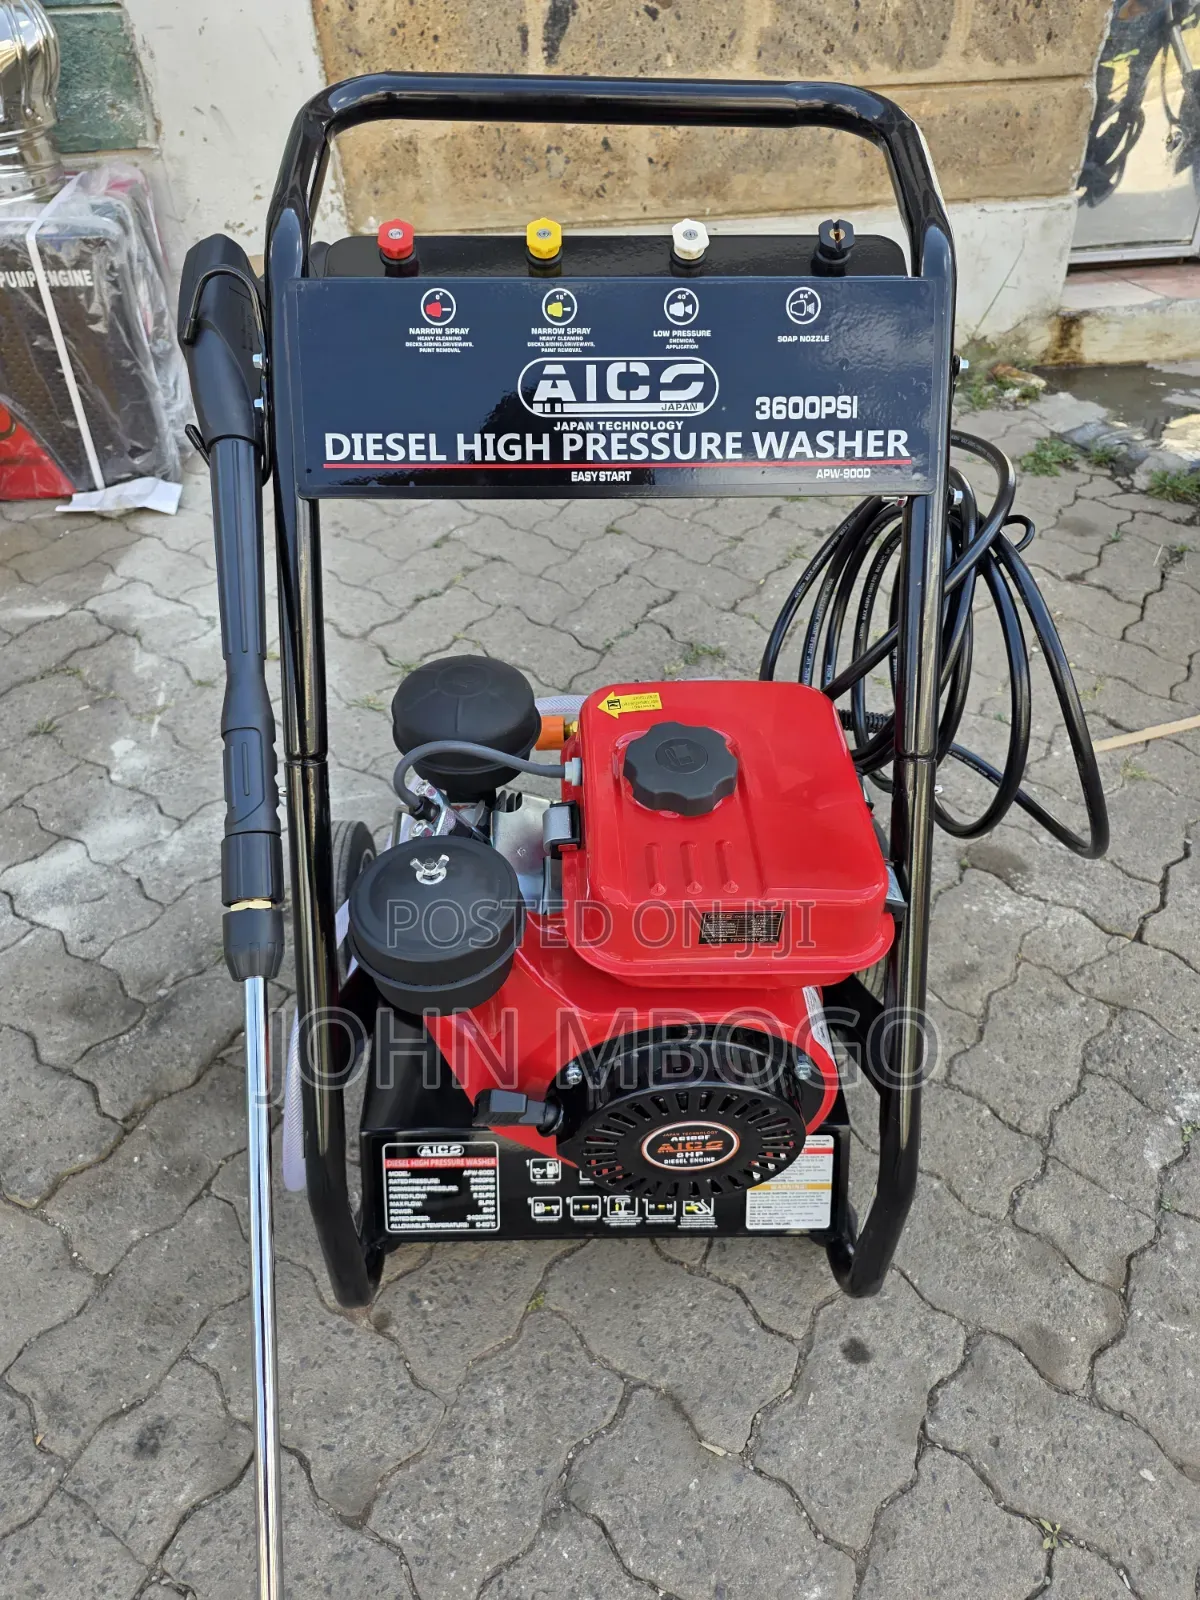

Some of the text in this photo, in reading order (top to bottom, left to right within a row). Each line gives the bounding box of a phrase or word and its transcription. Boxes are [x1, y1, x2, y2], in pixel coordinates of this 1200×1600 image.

[532, 362, 705, 401] AICS
[661, 403, 698, 411] JAPAN
[755, 395, 858, 420] 3600PSI
[553, 420, 684, 431] JAPAN TECHNOLOGY
[324, 429, 910, 462] DIESEL HIGH PRESSURE WASHER
[571, 471, 631, 482] EASY START
[420, 1145, 462, 1156] AICS
[387, 1159, 410, 1167] DIESEL
[430, 1158, 464, 1166] PRESSURE
[466, 1158, 496, 1166] WASHER
[690, 1156, 716, 1164] ENGINE
